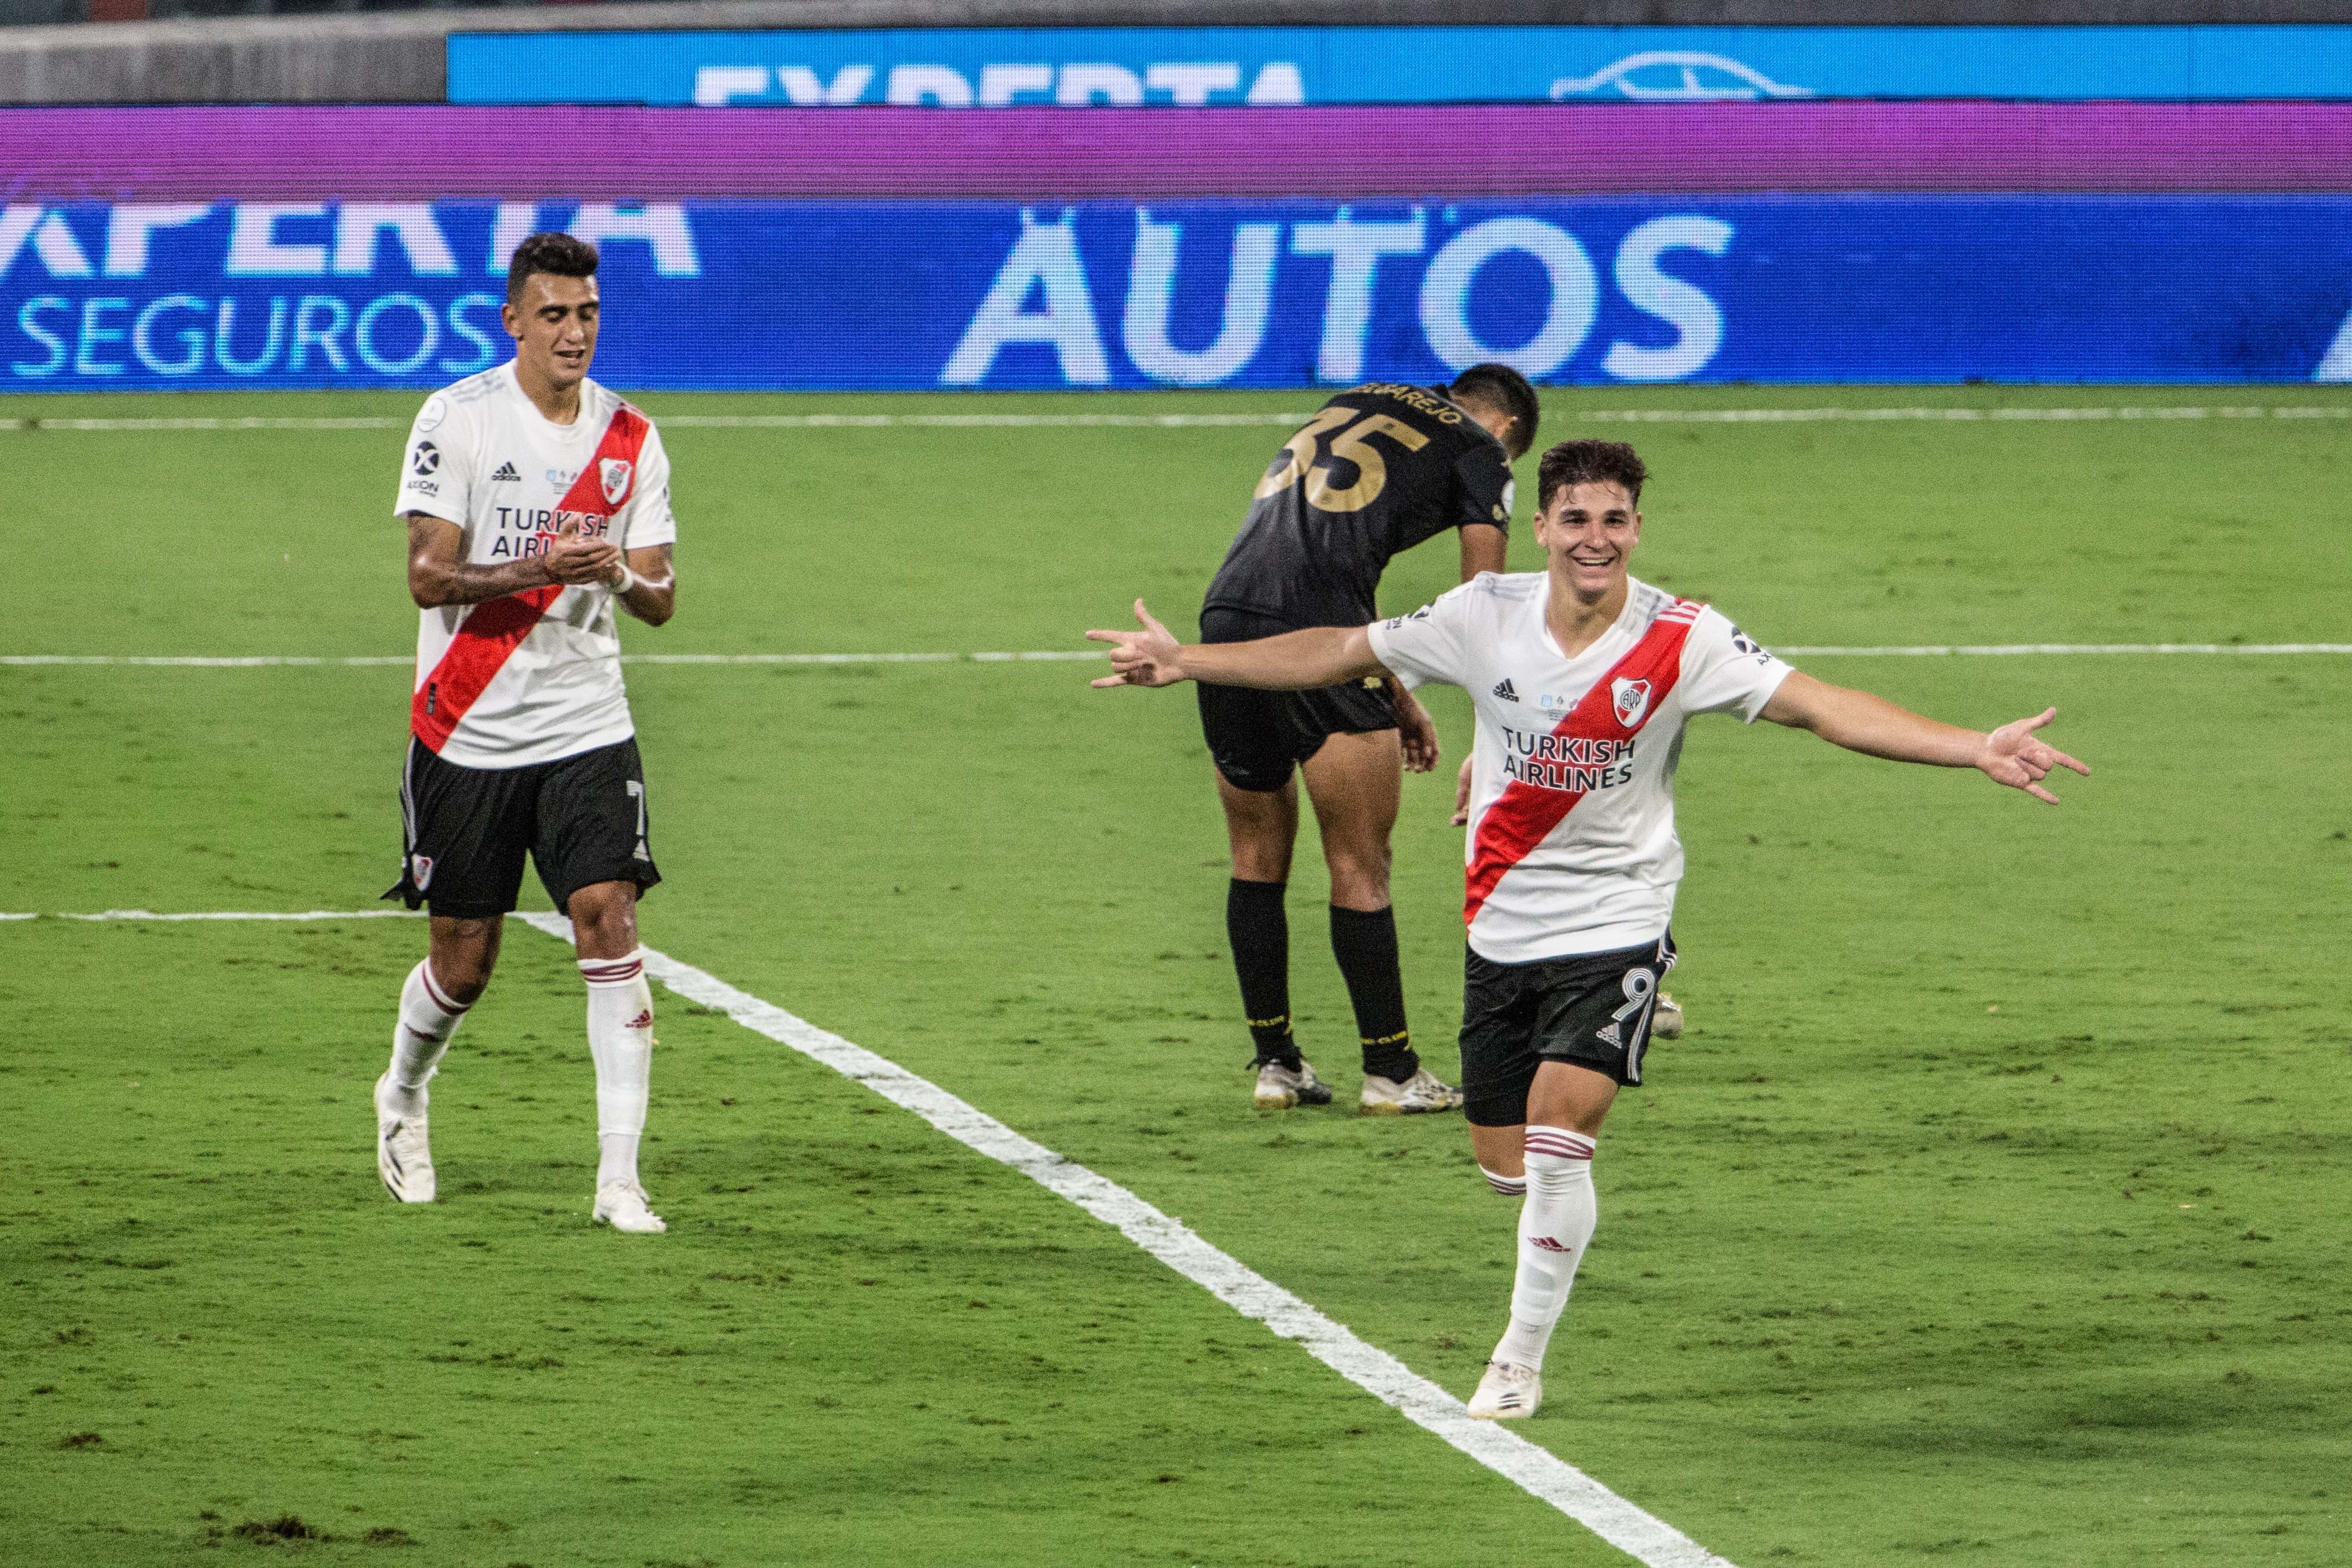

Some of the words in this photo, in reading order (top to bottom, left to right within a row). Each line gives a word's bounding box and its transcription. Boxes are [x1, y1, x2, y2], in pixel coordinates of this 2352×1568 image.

[934, 212, 1733, 384] AUTOS
[10, 293, 502, 377] SEGUROS
[1254, 406, 1431, 513] 35
[495, 506, 610, 537] TURKSH
[1501, 725, 1636, 765] TURKISH
[1503, 754, 1633, 792] AIRLINES
[1611, 967, 1656, 1022] 9
